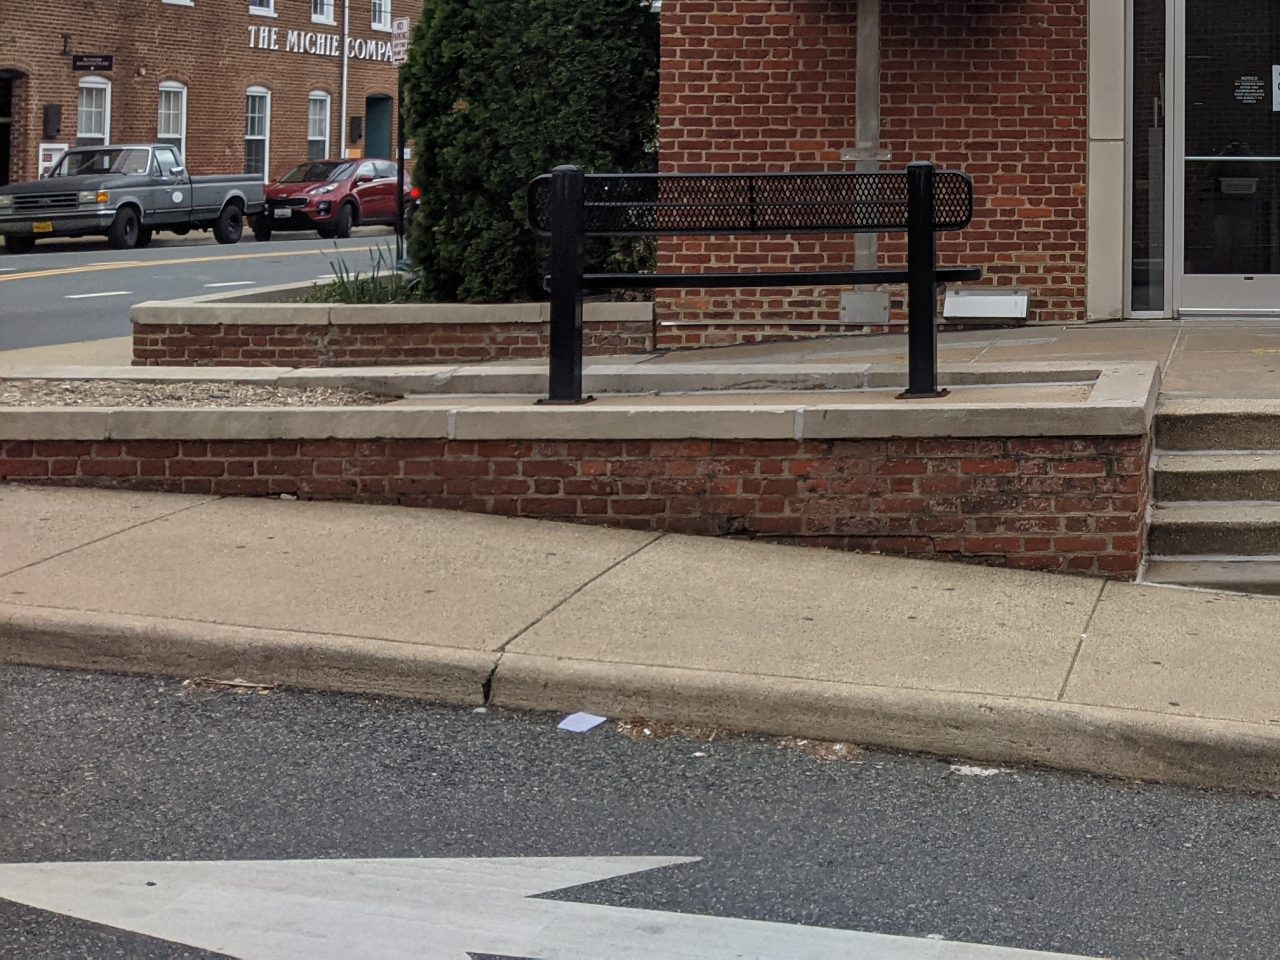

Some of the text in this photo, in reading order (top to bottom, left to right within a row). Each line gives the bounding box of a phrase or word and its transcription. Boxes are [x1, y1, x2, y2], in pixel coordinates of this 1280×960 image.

[397, 21, 404, 31] NO
[248, 25, 393, 62] THE MICHIE COMPA
